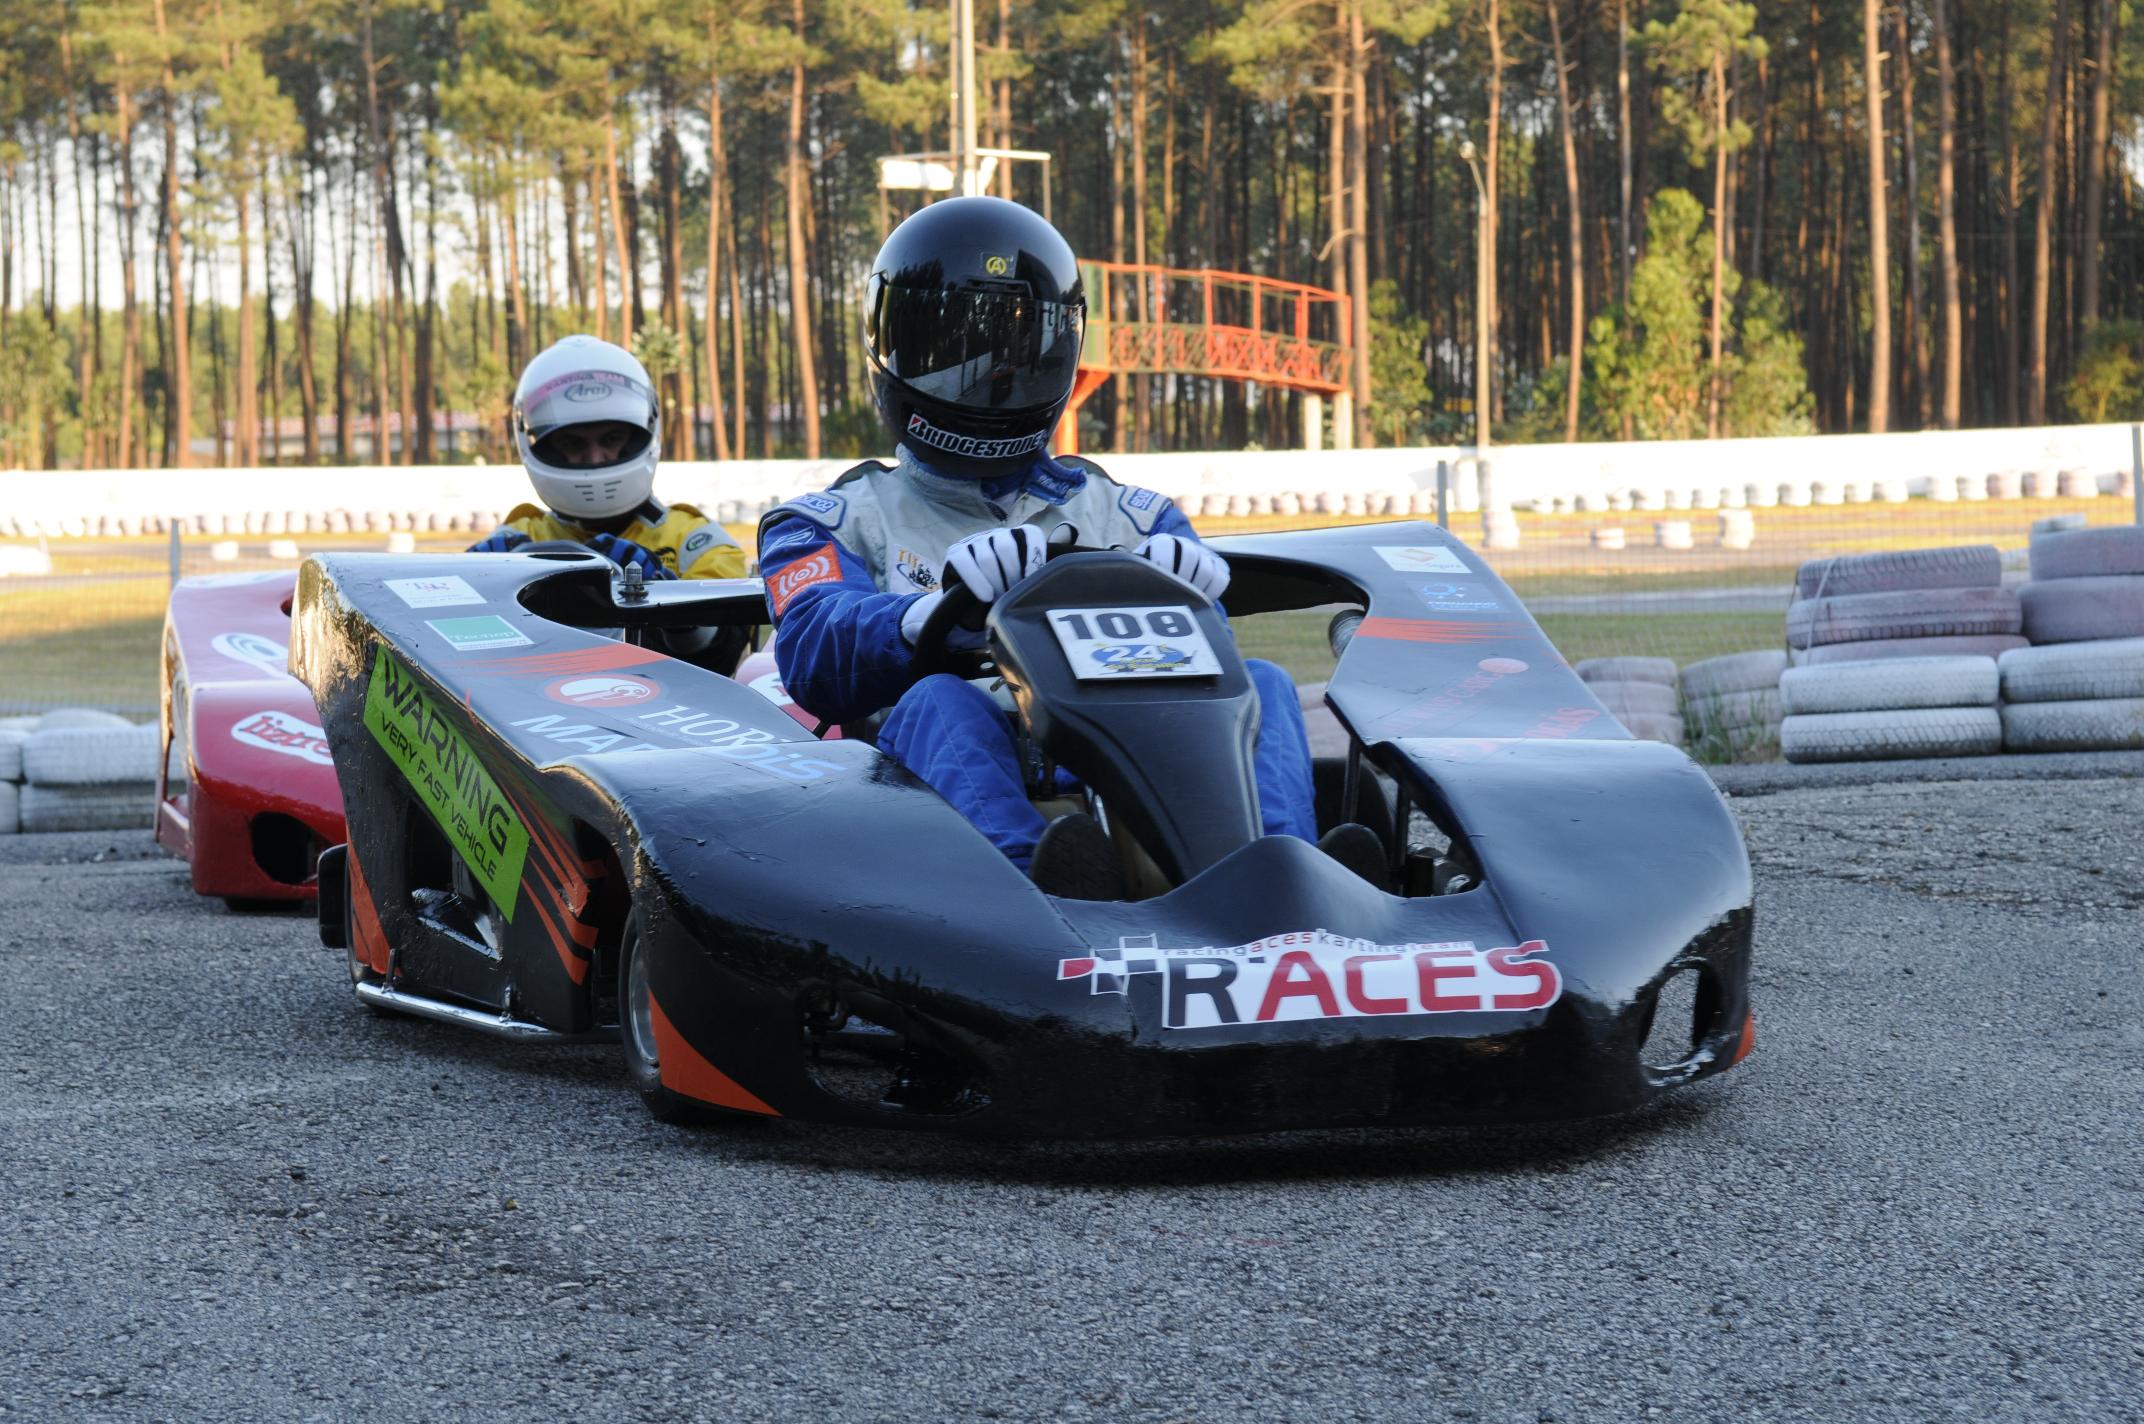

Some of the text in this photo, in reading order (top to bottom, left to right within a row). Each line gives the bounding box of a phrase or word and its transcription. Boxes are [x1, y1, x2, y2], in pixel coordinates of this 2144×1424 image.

[907, 413, 1048, 459] BRIDGESTONE
[1057, 611, 1193, 640] 109
[1102, 645, 1165, 662] 24
[384, 653, 511, 856] WARNING
[381, 713, 497, 882] VERY FAST VEHICLE
